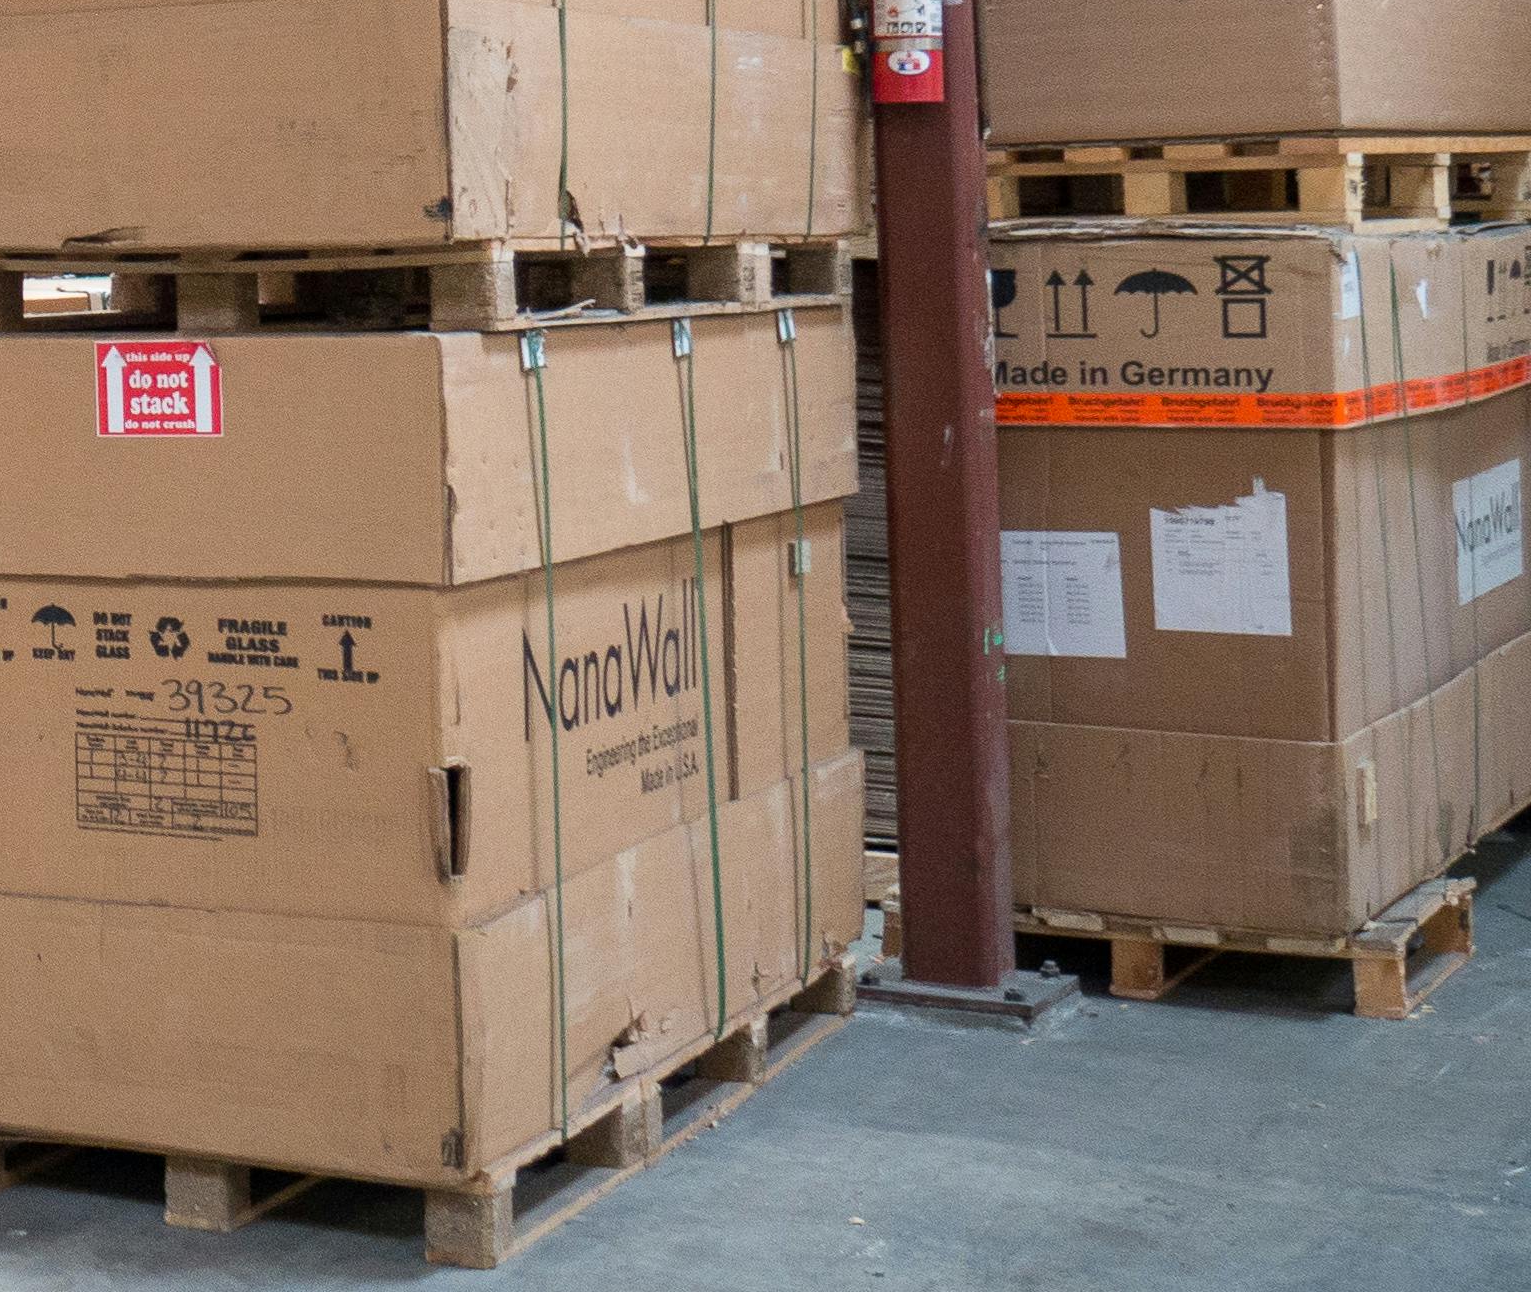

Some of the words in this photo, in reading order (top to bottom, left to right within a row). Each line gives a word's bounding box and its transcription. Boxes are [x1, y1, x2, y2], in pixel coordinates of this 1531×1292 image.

[125, 352, 148, 362] this
[150, 352, 172, 362] side
[175, 353, 190, 364] up
[129, 370, 152, 388] do
[156, 371, 188, 388] not
[1080, 360, 1109, 386] in
[1120, 360, 1274, 393] Germany
[130, 391, 189, 415] stack
[125, 419, 139, 429] do
[141, 420, 160, 429] not
[163, 420, 195, 429] crush
[218, 618, 287, 636] FRAGILE
[323, 613, 372, 629] CAUTION
[96, 628, 130, 642] STACK
[95, 644, 131, 659] GLASS
[225, 636, 280, 653] GLASS
[522, 577, 697, 741] NanaWall
[161, 678, 292, 716] 39325
